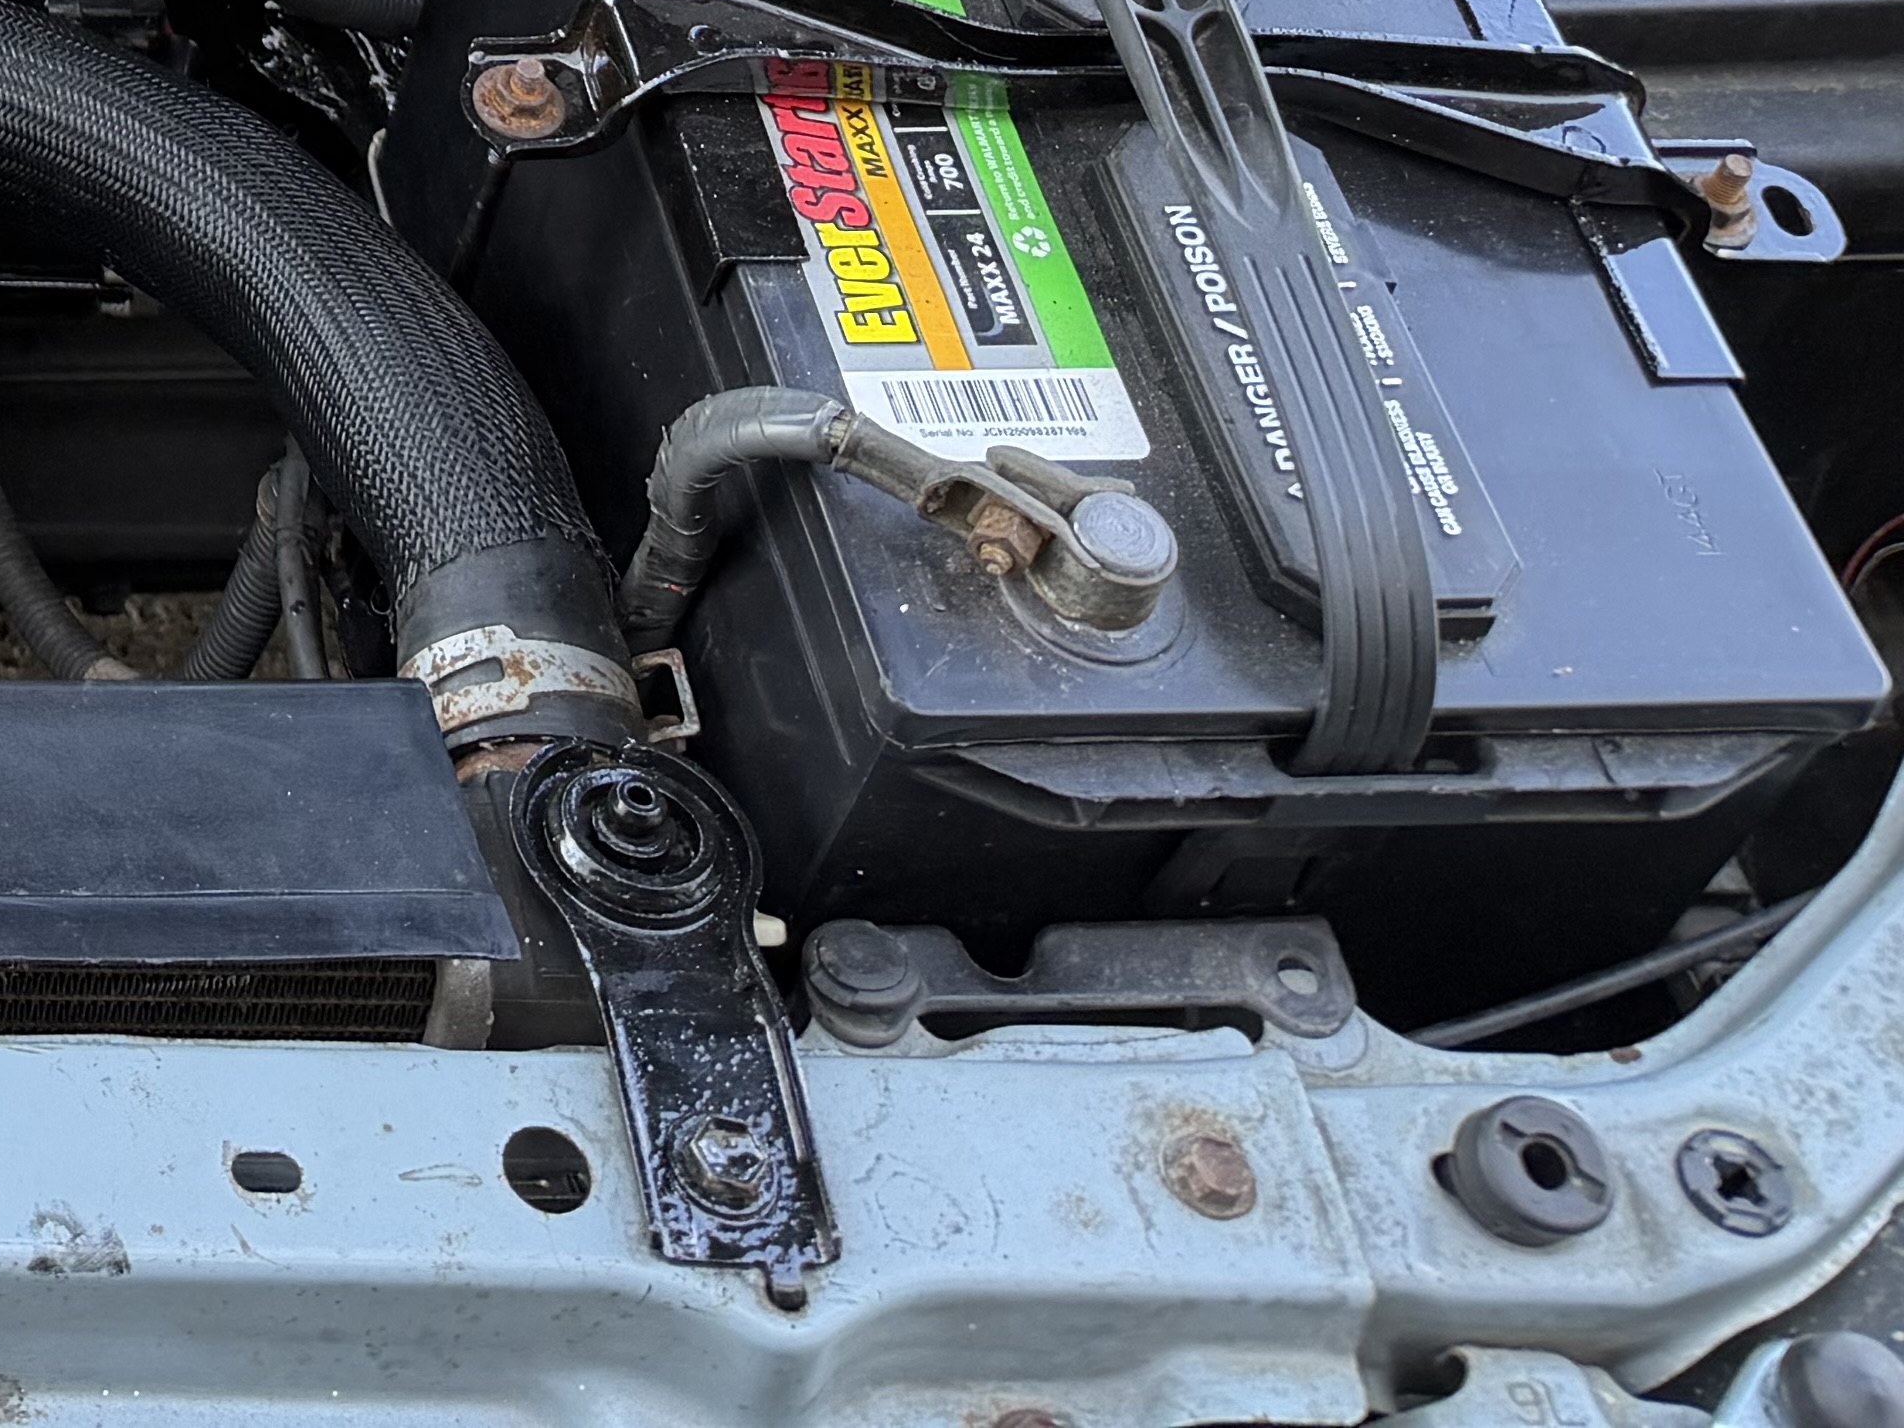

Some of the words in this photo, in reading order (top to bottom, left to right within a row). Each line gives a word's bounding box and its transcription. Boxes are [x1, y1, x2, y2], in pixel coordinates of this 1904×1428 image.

[844, 106, 888, 179] MAXX
[967, 113, 998, 171] WALMART
[992, 127, 1015, 164] toward
[934, 153, 964, 192] 700
[993, 170, 1003, 185] to
[1007, 163, 1025, 198] credit
[761, 93, 922, 345] EverStart
[999, 186, 1020, 222] Return
[1023, 199, 1036, 221] and
[965, 231, 993, 258] 24
[1163, 203, 1239, 314] POISON
[947, 248, 971, 295] Number
[967, 295, 979, 310] Part
[977, 260, 1021, 326] MAXX
[1226, 343, 1295, 472] DANGER
[919, 428, 954, 439] Serial
